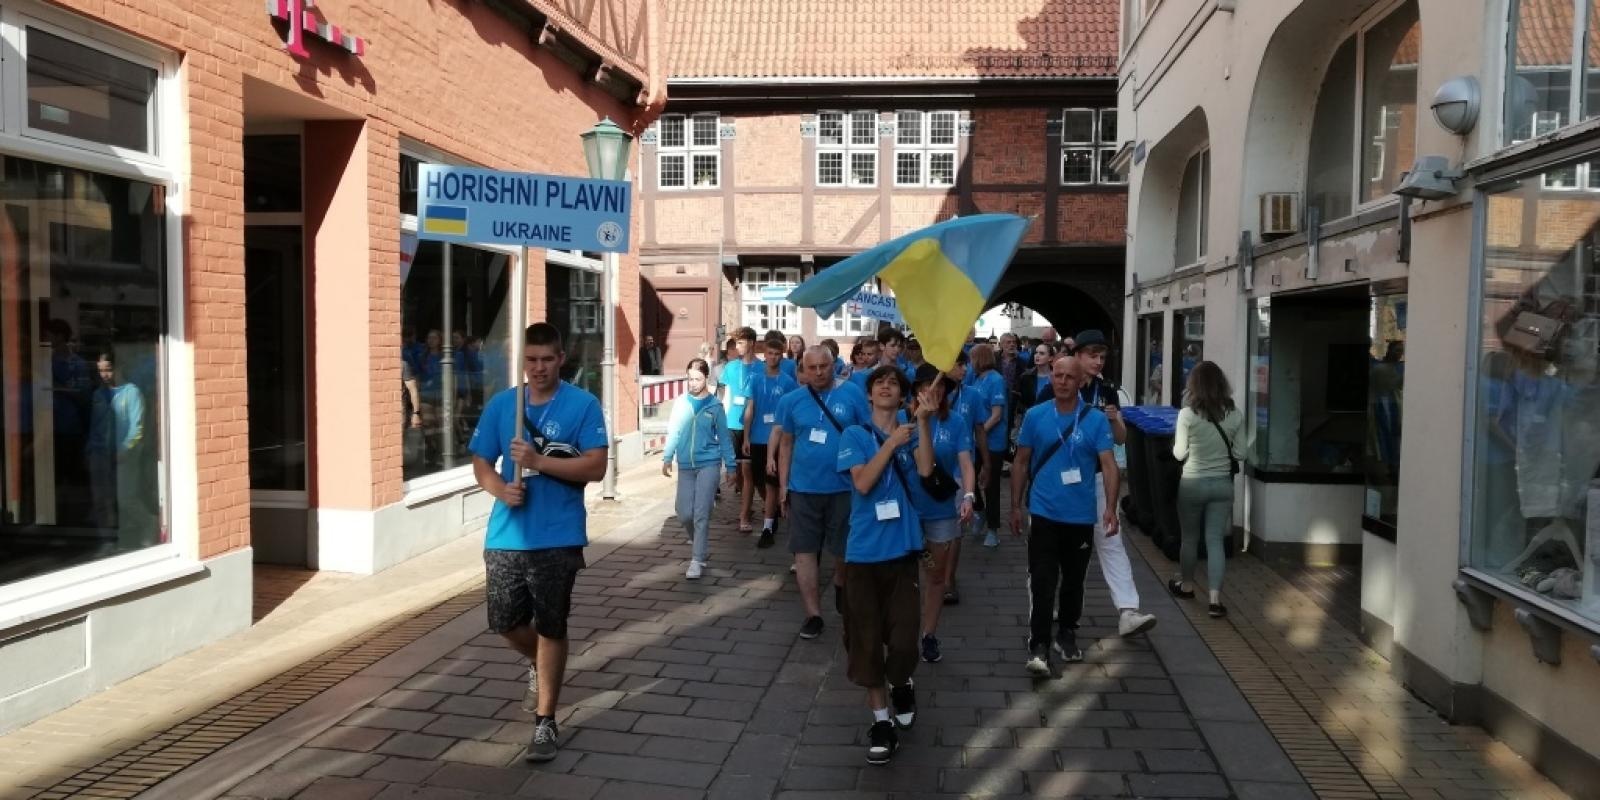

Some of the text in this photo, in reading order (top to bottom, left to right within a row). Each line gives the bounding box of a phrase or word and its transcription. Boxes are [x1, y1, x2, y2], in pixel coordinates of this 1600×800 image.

[425, 171, 626, 213] HORISHNI PLAVNI
[492, 220, 572, 242] UKRAINE
